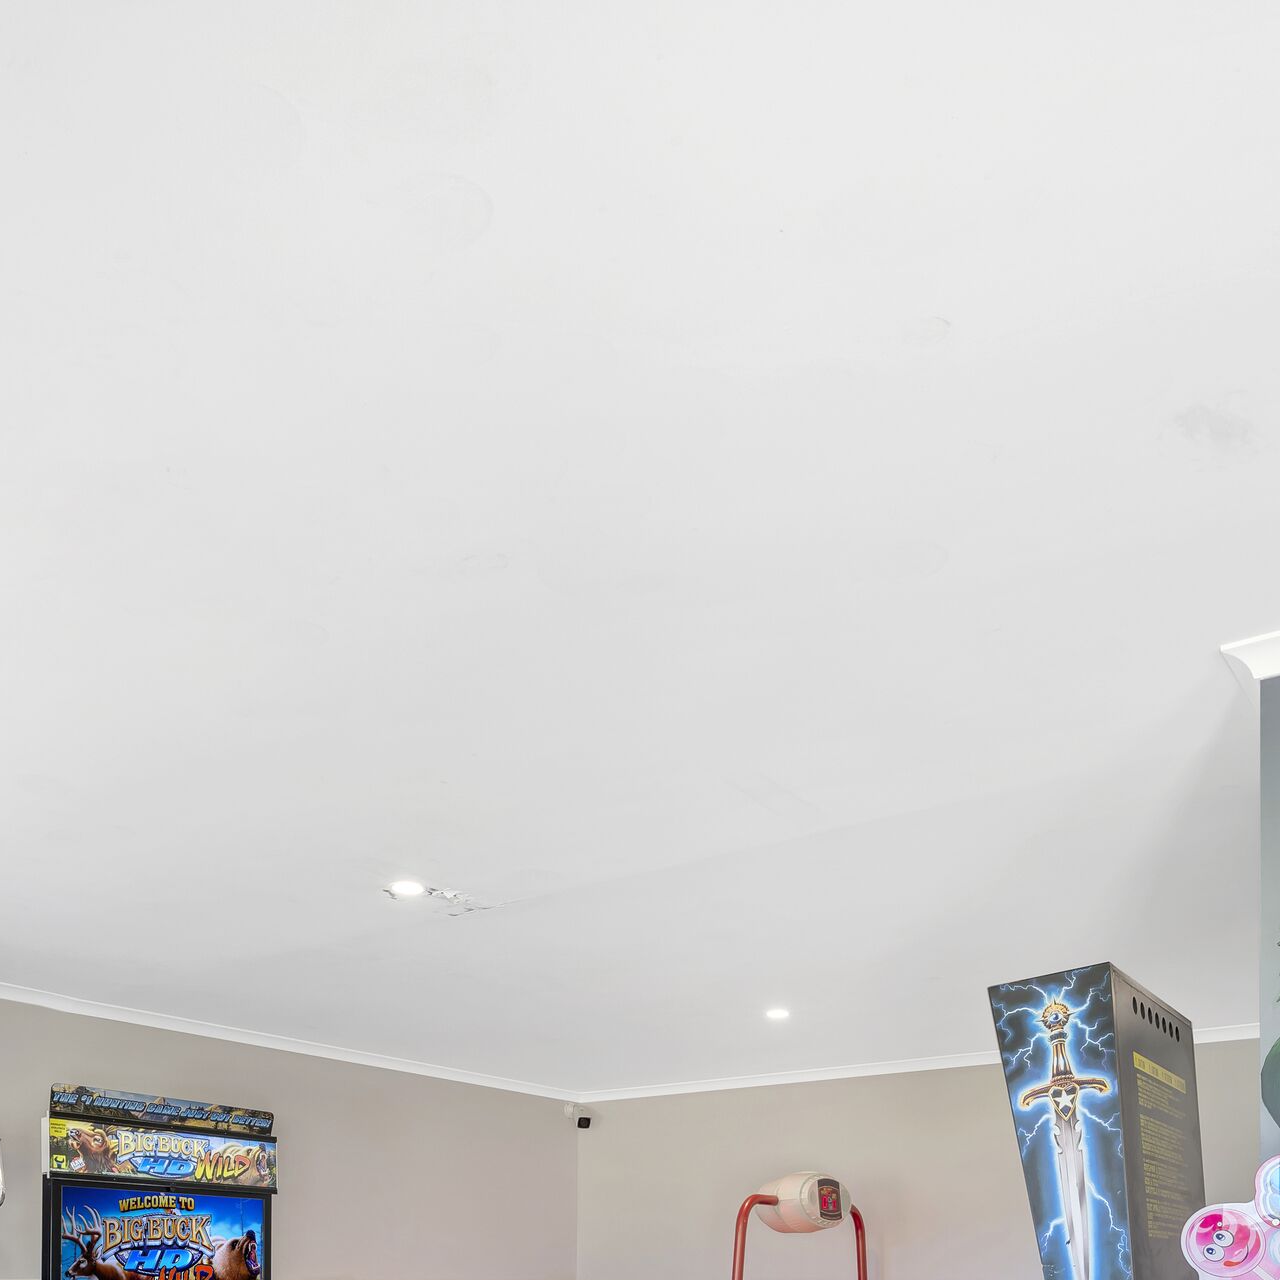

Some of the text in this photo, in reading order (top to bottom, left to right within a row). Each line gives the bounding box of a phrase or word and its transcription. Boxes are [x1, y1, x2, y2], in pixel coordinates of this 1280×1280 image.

[52, 1092, 77, 1104] THE
[146, 1103, 181, 1116] GAME
[180, 1107, 210, 1120] JUST
[117, 1130, 210, 1158] BIG BUCK
[136, 1152, 252, 1182] HD WILD
[119, 1195, 195, 1212] WELCOME TO
[103, 1215, 214, 1251] BIG BUCK
[124, 1249, 193, 1271] HD
